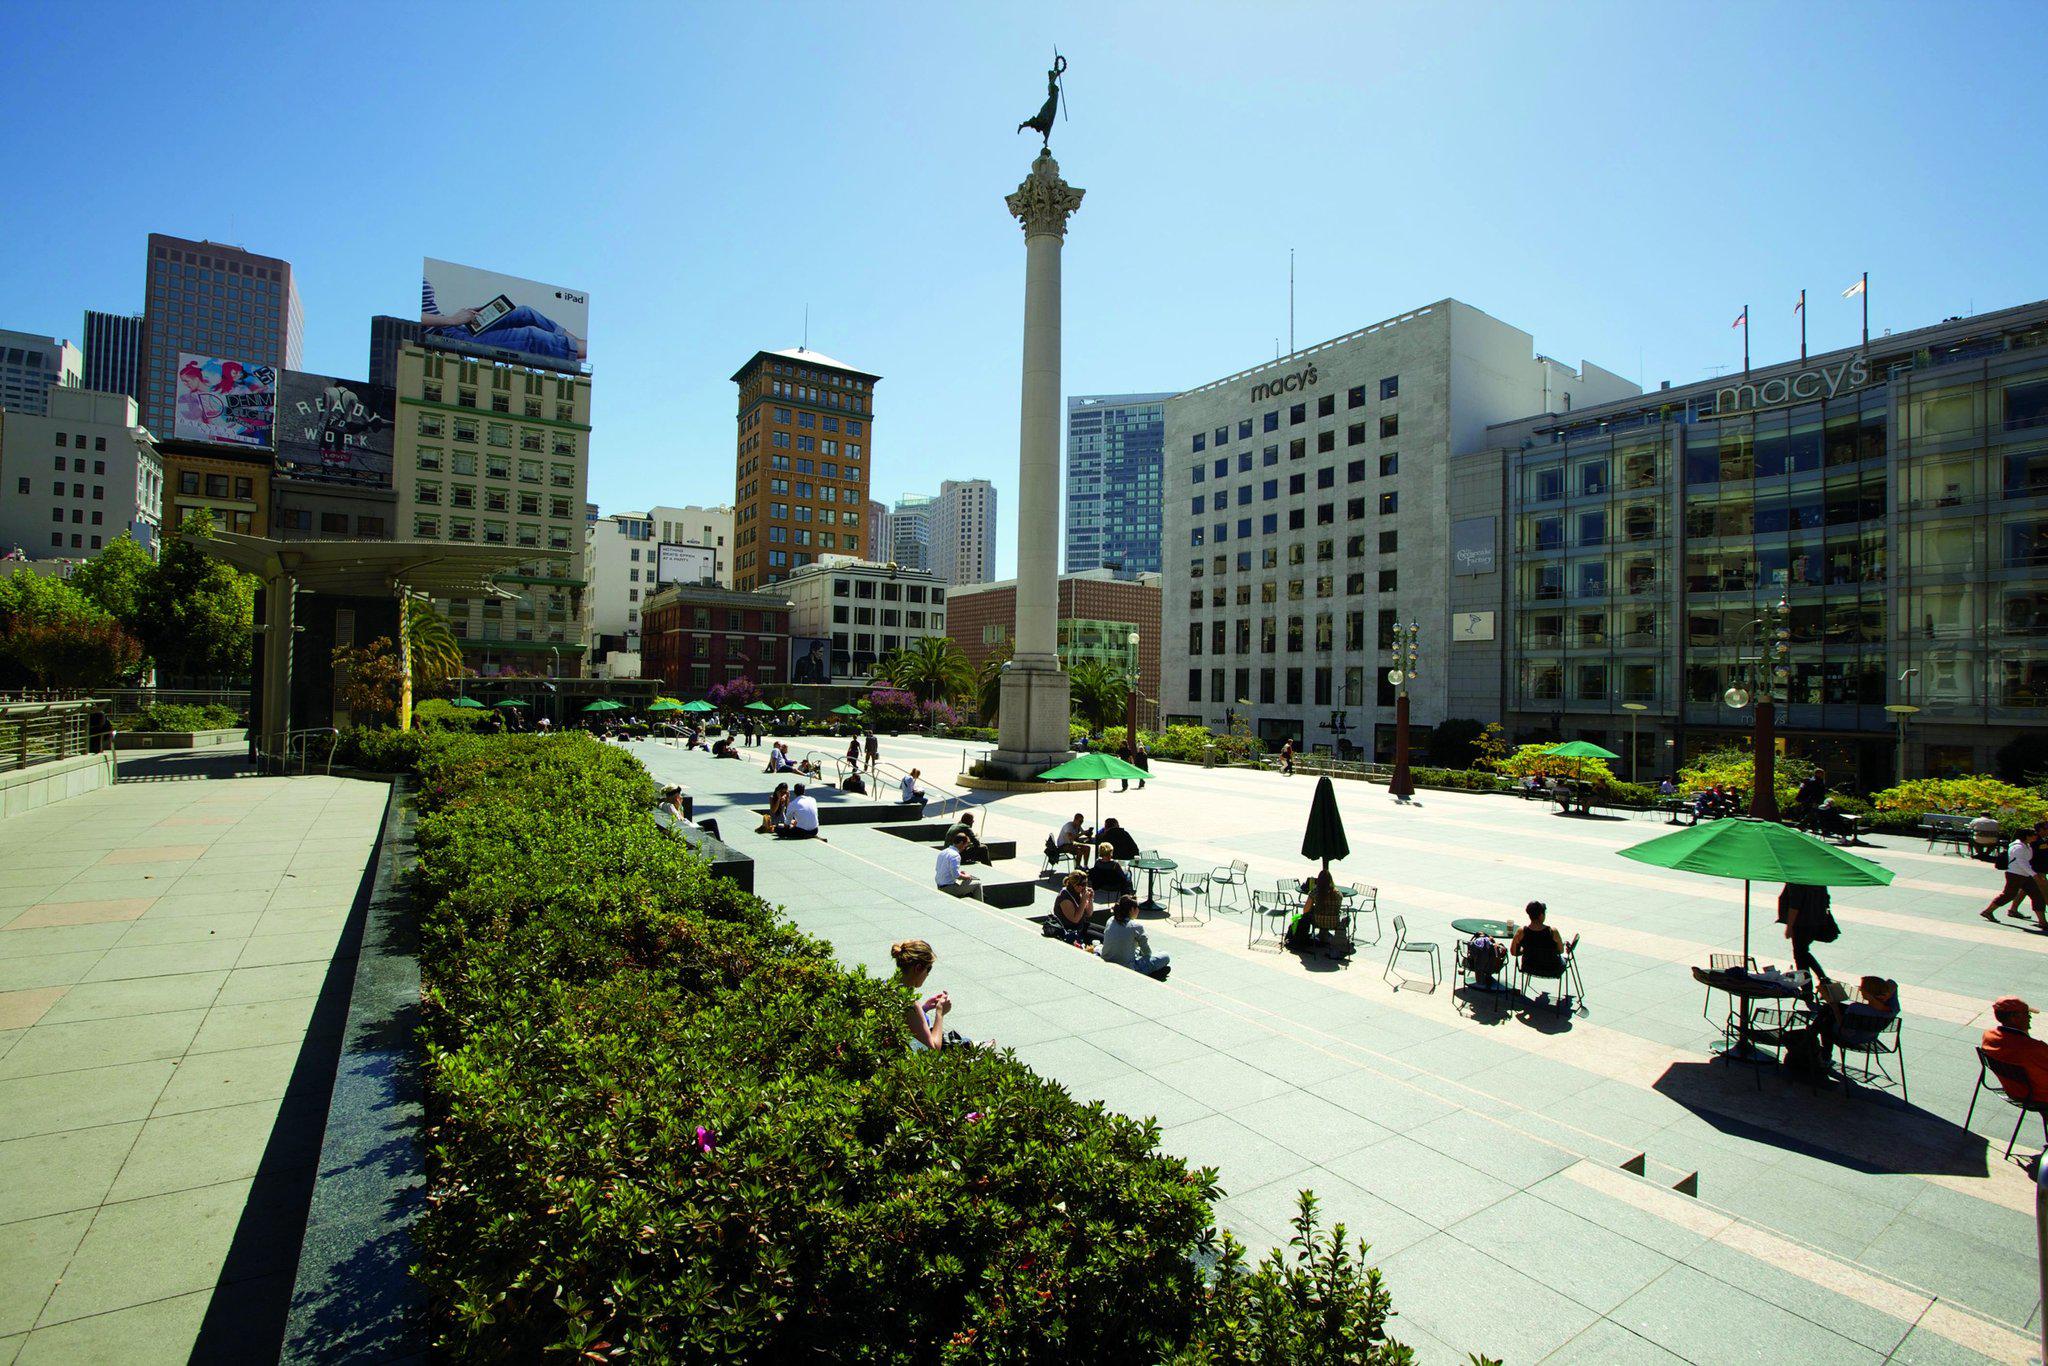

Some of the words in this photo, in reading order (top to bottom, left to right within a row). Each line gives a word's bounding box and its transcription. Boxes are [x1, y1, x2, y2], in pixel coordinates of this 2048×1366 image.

[564, 292, 584, 304] iPad
[1251, 362, 1318, 403] macy's
[1716, 353, 1869, 413] macy's
[296, 398, 381, 422] READY
[329, 416, 346, 428] TO
[304, 428, 368, 447] WORK
